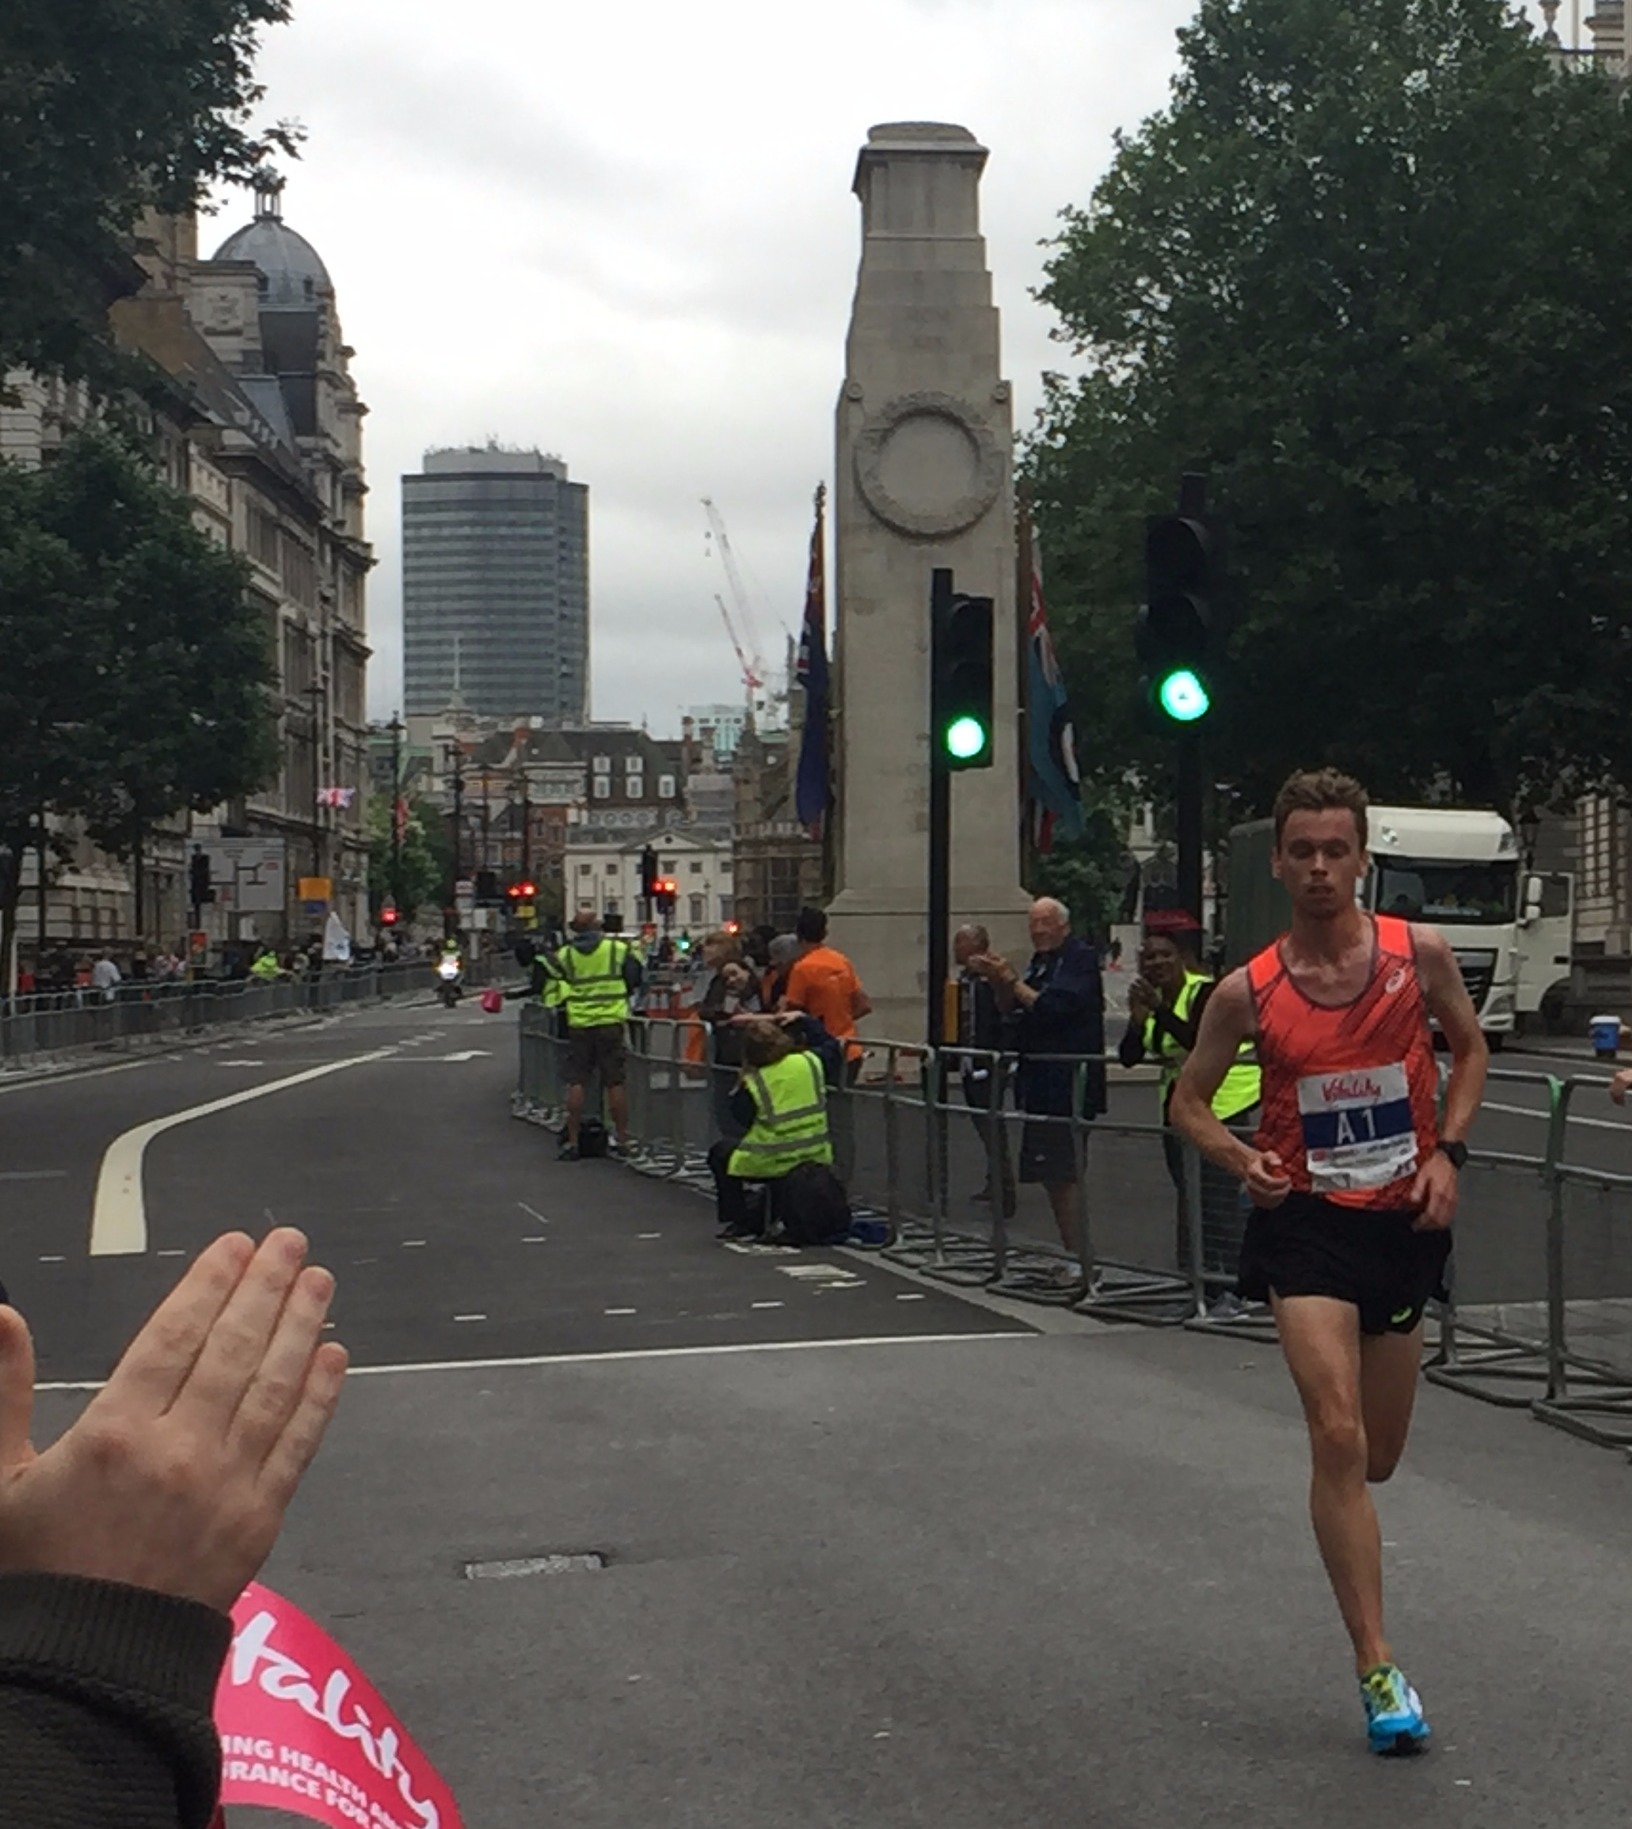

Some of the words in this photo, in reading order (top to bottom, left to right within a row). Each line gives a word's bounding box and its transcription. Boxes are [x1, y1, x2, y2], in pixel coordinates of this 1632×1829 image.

[1321, 1076, 1382, 1104] Vitality
[231, 1590, 440, 1829] tality
[220, 1734, 274, 1760] ING
[280, 1745, 368, 1808] HEALTH
[325, 1787, 371, 1829] FOR
